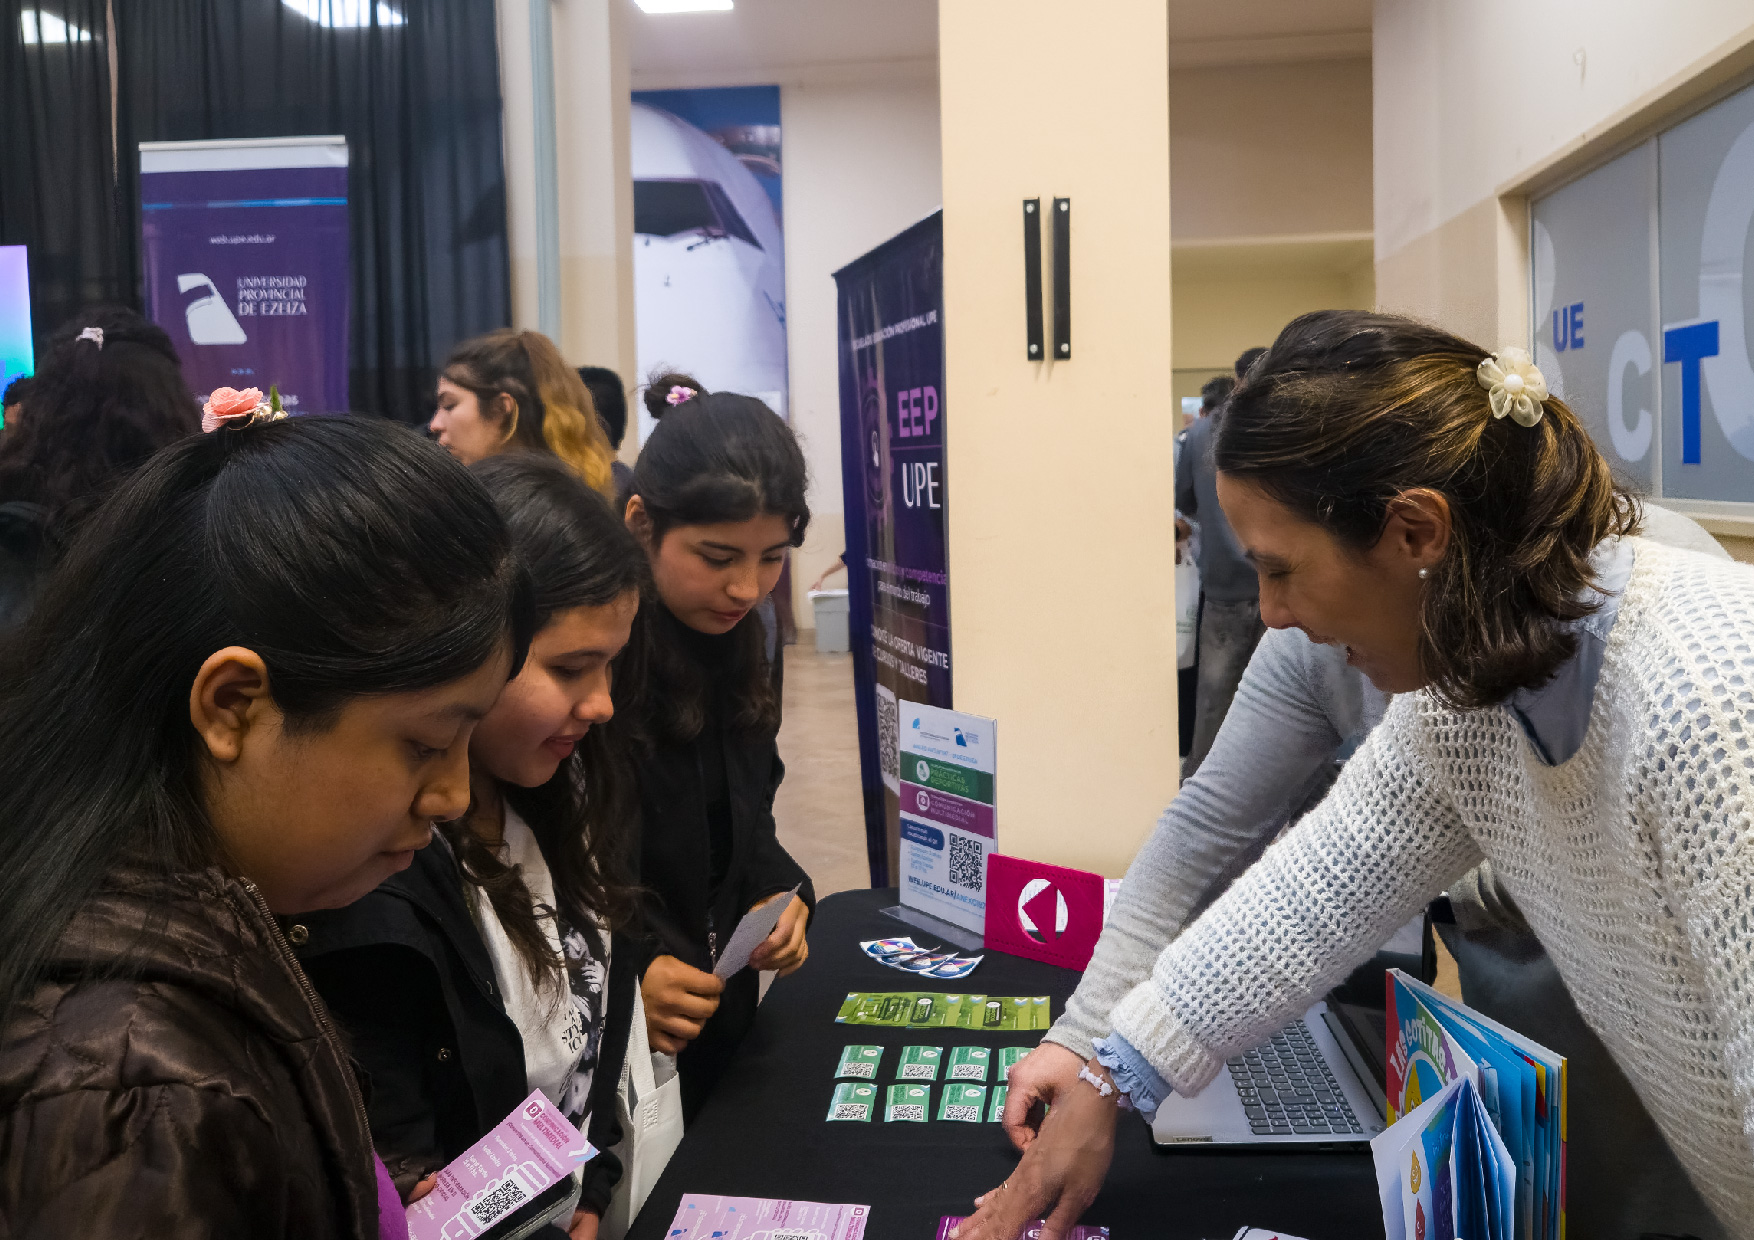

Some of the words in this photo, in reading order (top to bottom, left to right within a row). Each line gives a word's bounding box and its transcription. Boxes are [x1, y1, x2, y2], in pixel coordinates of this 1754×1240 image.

[237, 275, 307, 288] UNIVERSIDAD
[238, 288, 305, 300] PROVINCIAL
[239, 301, 257, 315] DE
[260, 301, 307, 315] EZEIZA
[1552, 302, 1584, 352] UE
[1664, 320, 1719, 464] T
[898, 386, 938, 437] EEP
[903, 462, 940, 509] UPE
[911, 590, 931, 608] trabajo
[916, 645, 949, 669] VIGENTE
